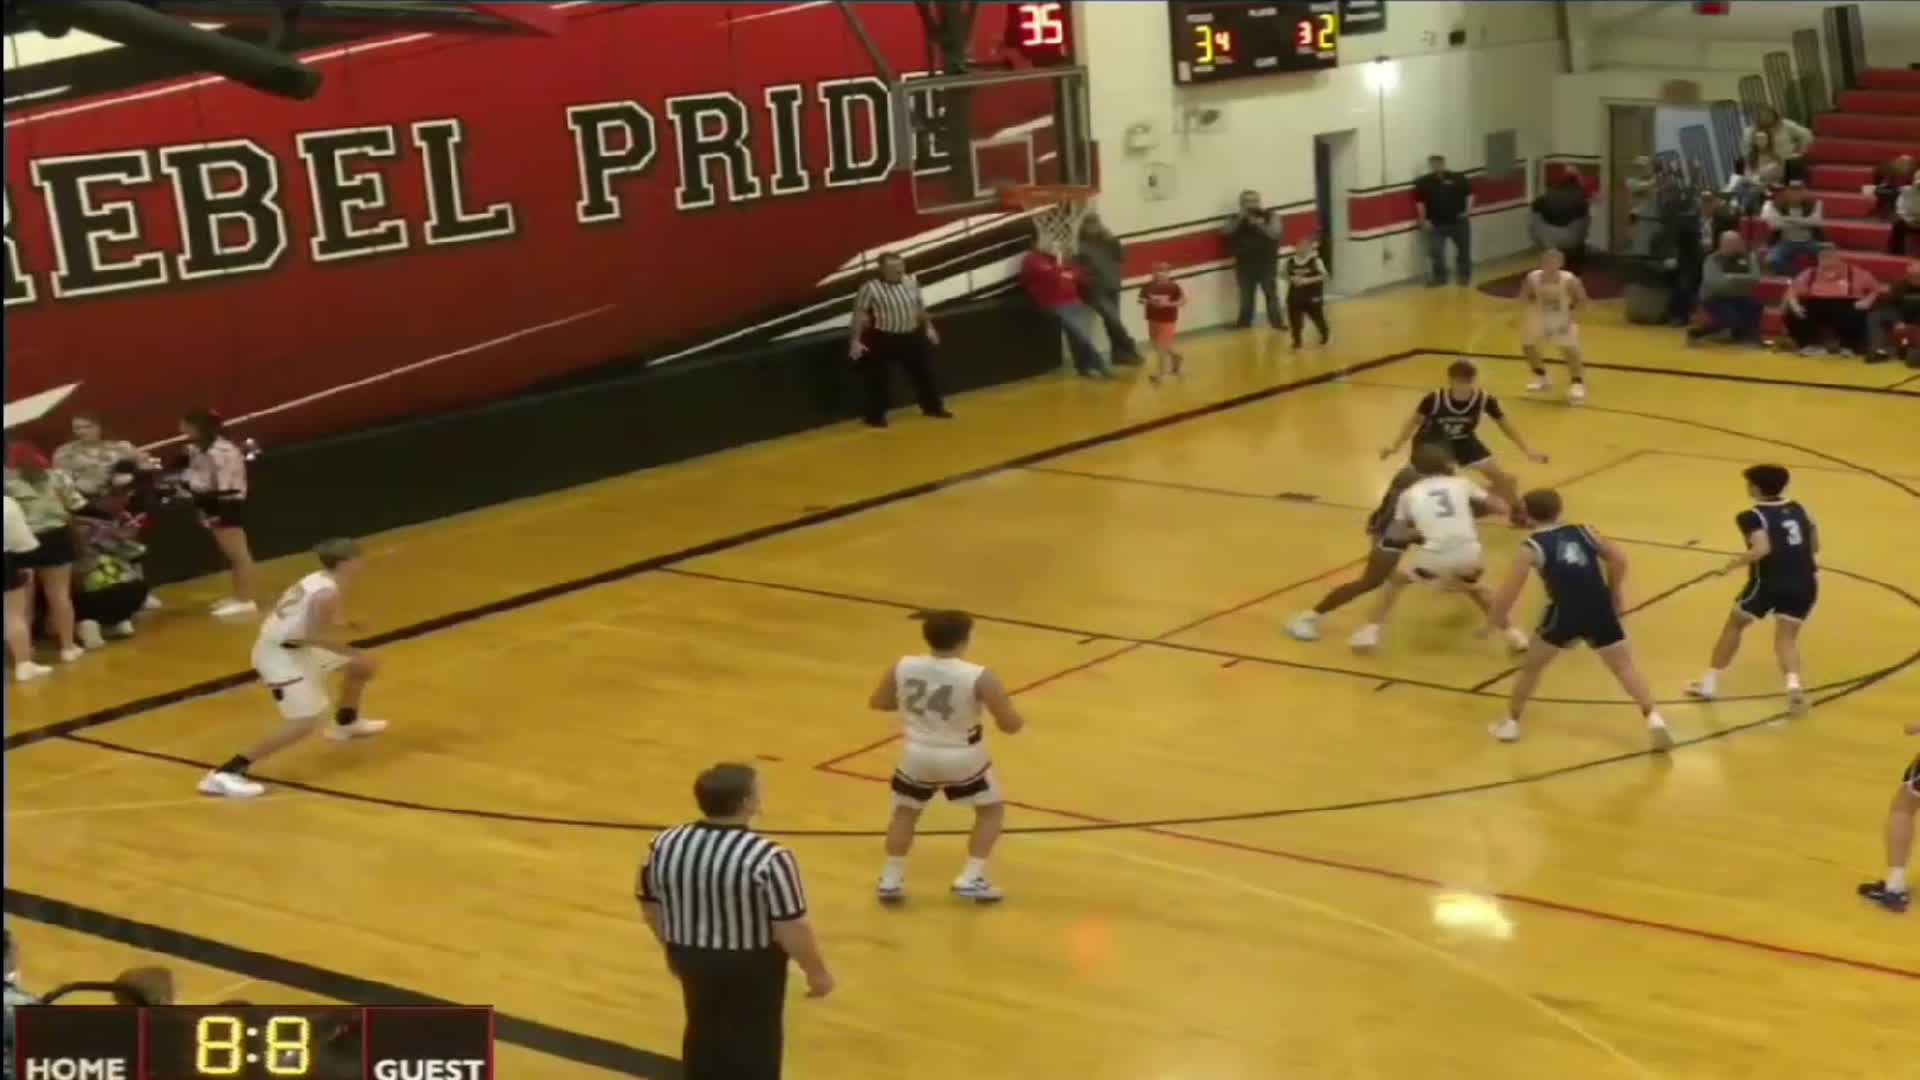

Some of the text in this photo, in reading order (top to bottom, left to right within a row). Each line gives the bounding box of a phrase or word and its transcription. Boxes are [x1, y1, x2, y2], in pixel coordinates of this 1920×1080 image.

[1019, 3, 1062, 46] 35
[1299, 14, 1334, 48] 3 2
[1429, 489, 1454, 518] 3
[1781, 519, 1802, 546] 3
[1557, 540, 1587, 566] 4
[903, 677, 954, 721] 24
